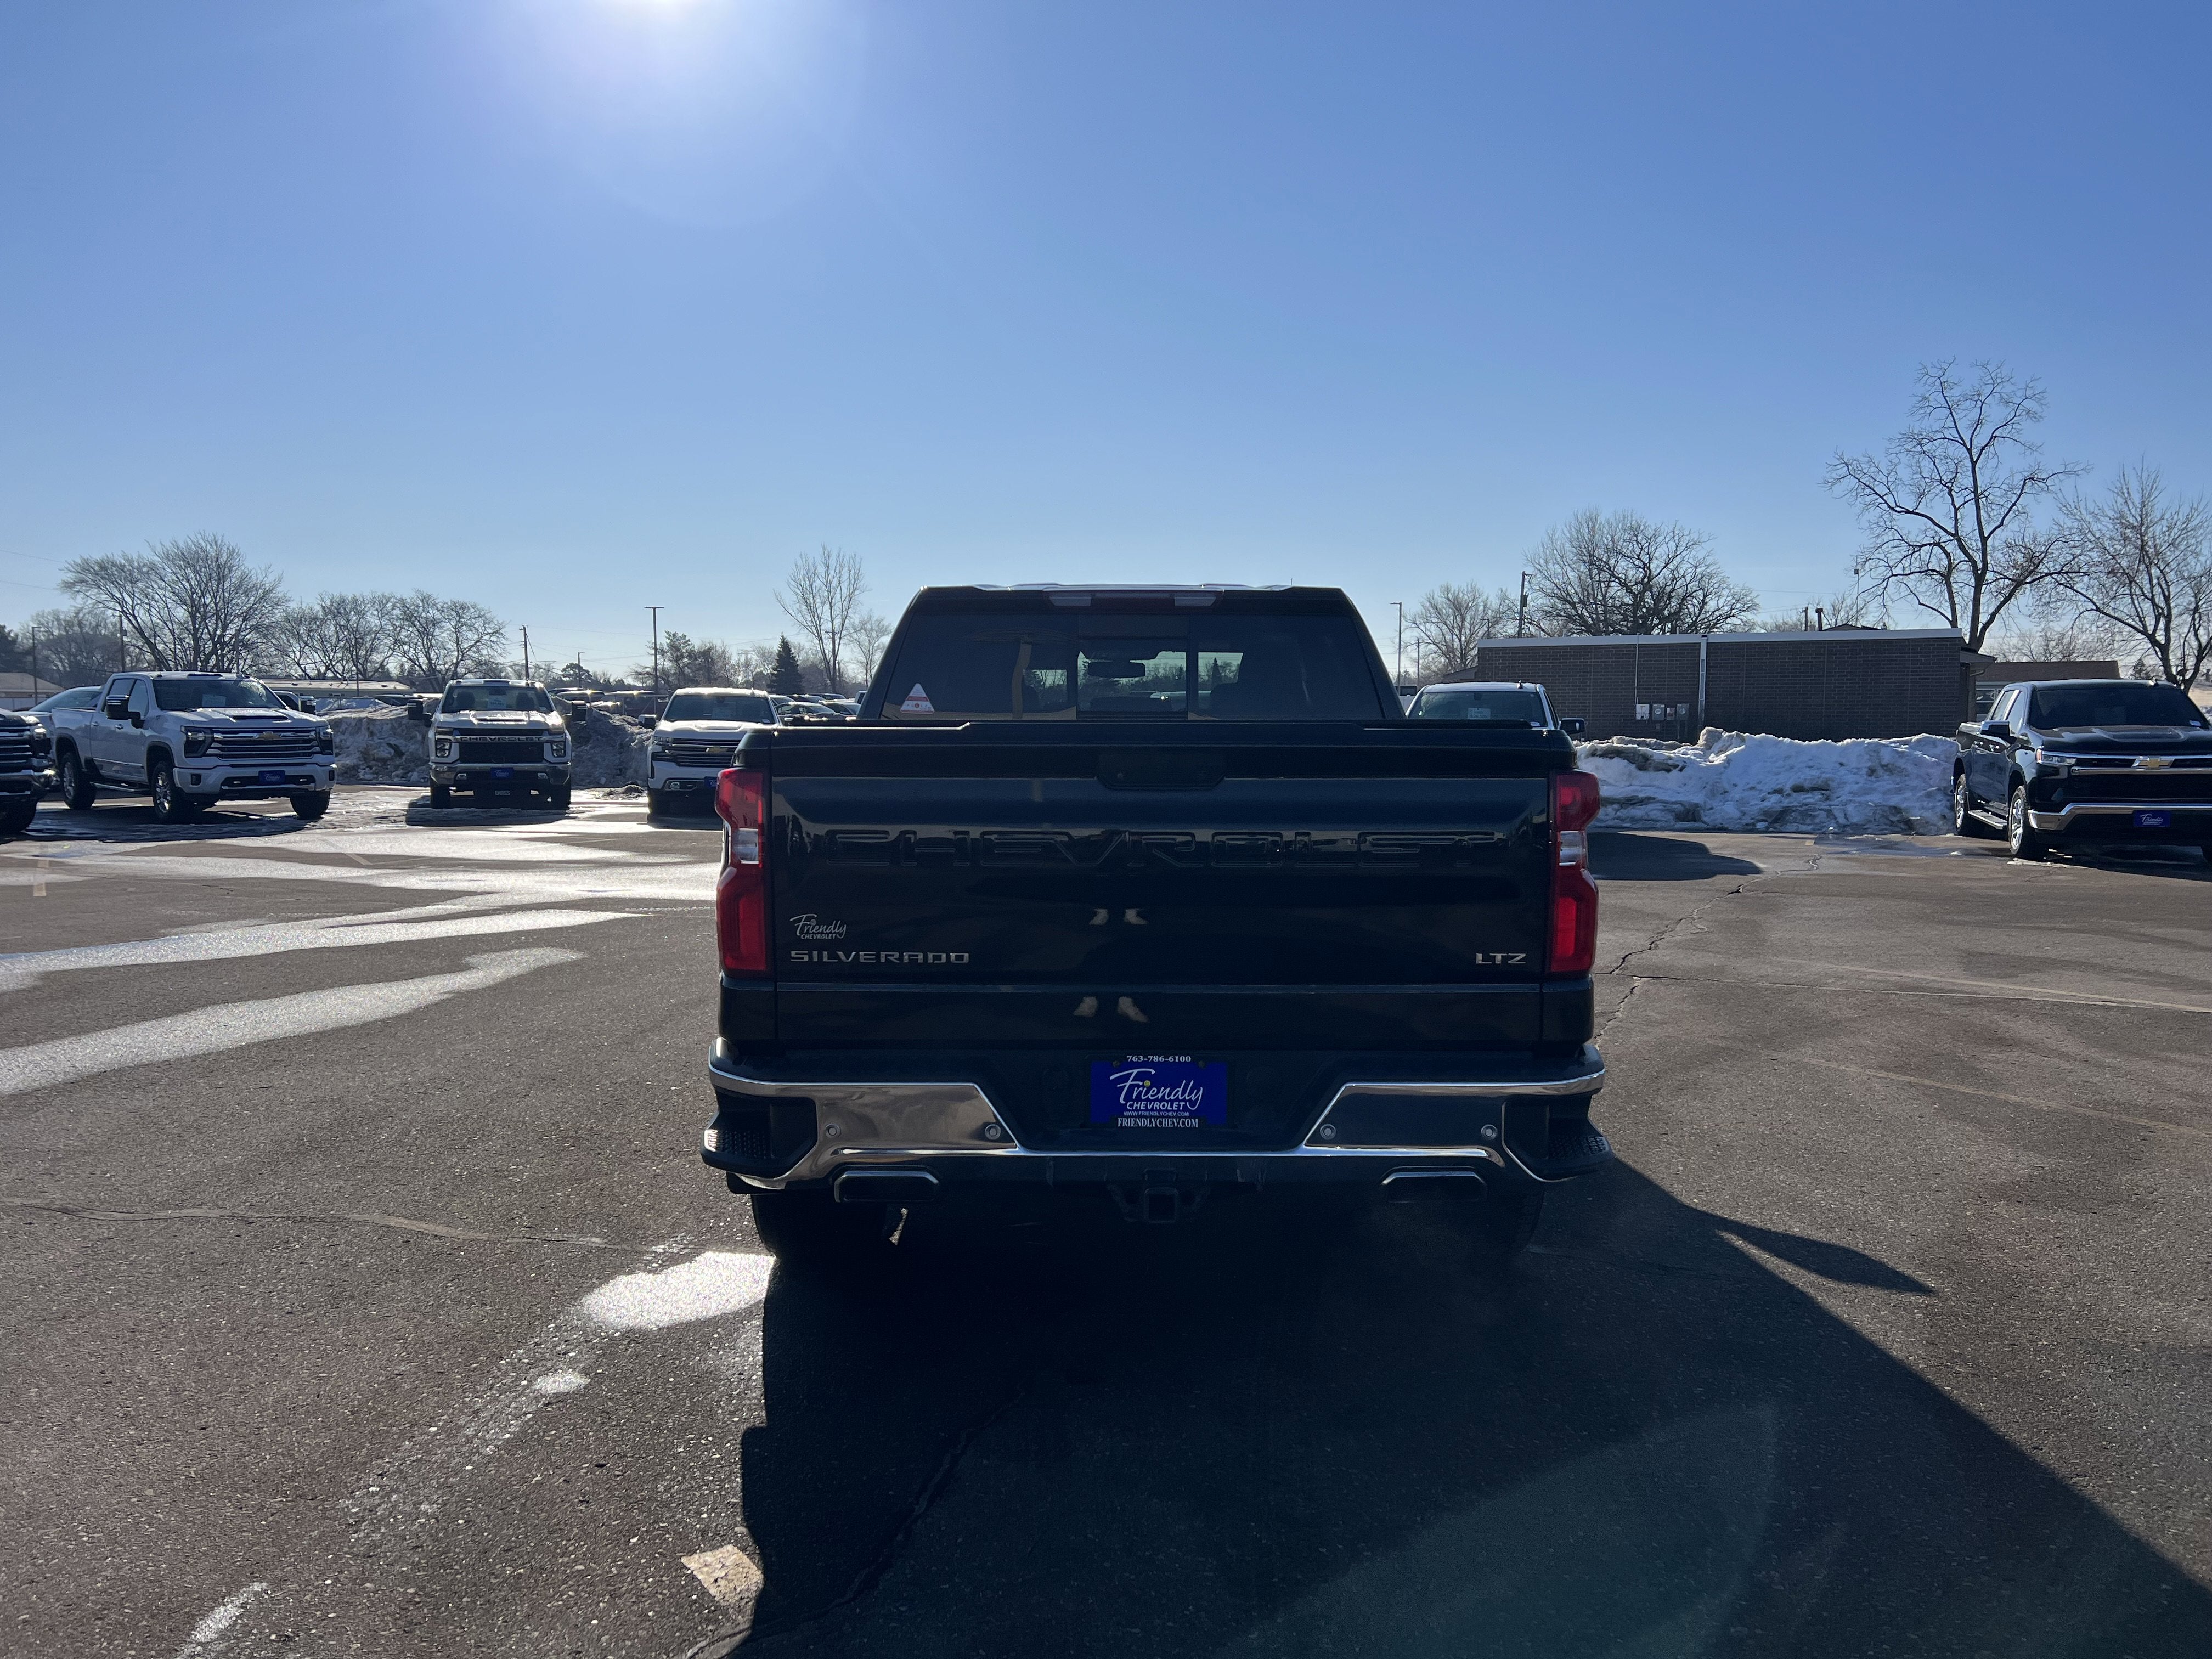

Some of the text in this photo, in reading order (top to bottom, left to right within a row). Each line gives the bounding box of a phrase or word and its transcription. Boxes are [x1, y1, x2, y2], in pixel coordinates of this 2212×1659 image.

[824, 829, 1497, 867] CHEVROLET
[789, 913, 847, 939] Friendly
[790, 950, 969, 963] SILVERADO
[1476, 953, 1526, 964] LTZ
[1109, 1068, 1203, 1110] Friendly
[1126, 1101, 1186, 1110] CHEVROLET
[1117, 1118, 1199, 1128] FRIENDLYCHEV.COM
